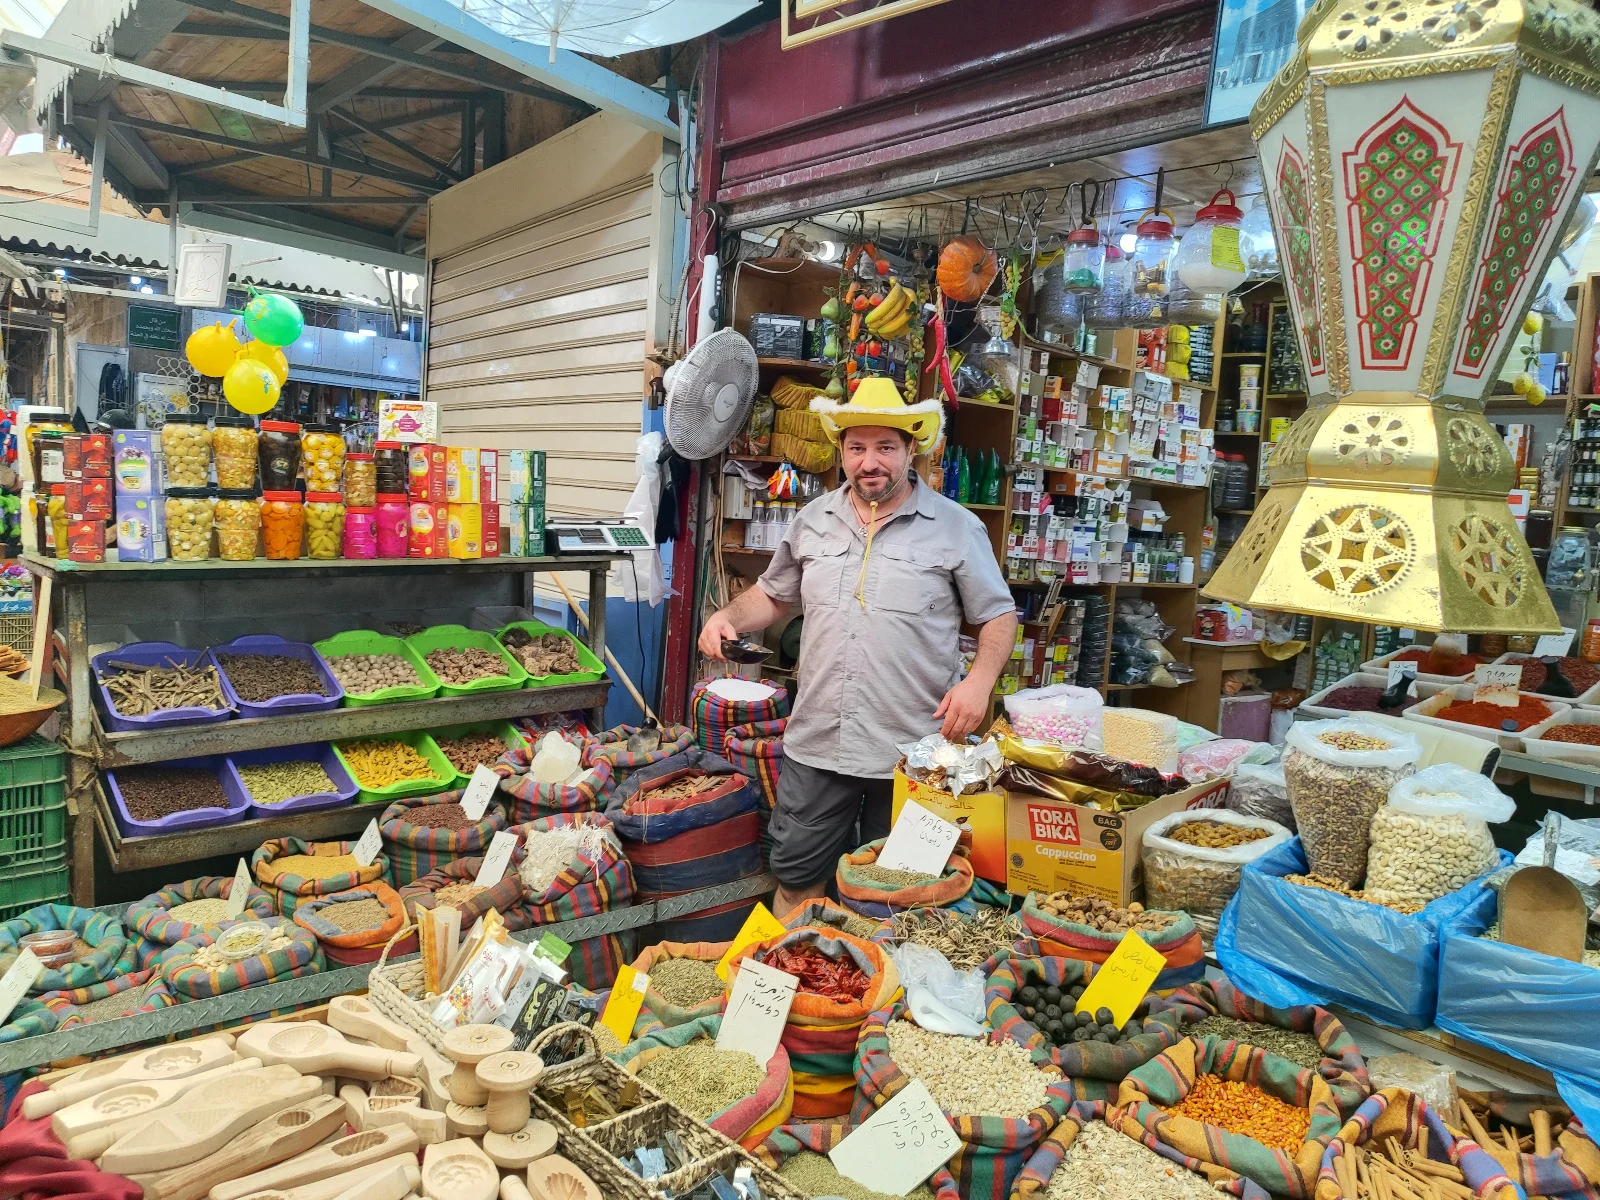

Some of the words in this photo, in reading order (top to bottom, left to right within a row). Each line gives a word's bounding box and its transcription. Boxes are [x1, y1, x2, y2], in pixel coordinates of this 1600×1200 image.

[945, 801, 975, 810] خالص
[1029, 808, 1077, 827] TORA
[1098, 817, 1117, 827] BAG
[1034, 823, 1077, 841] BIKA
[1035, 844, 1097, 862] Cappuccino
